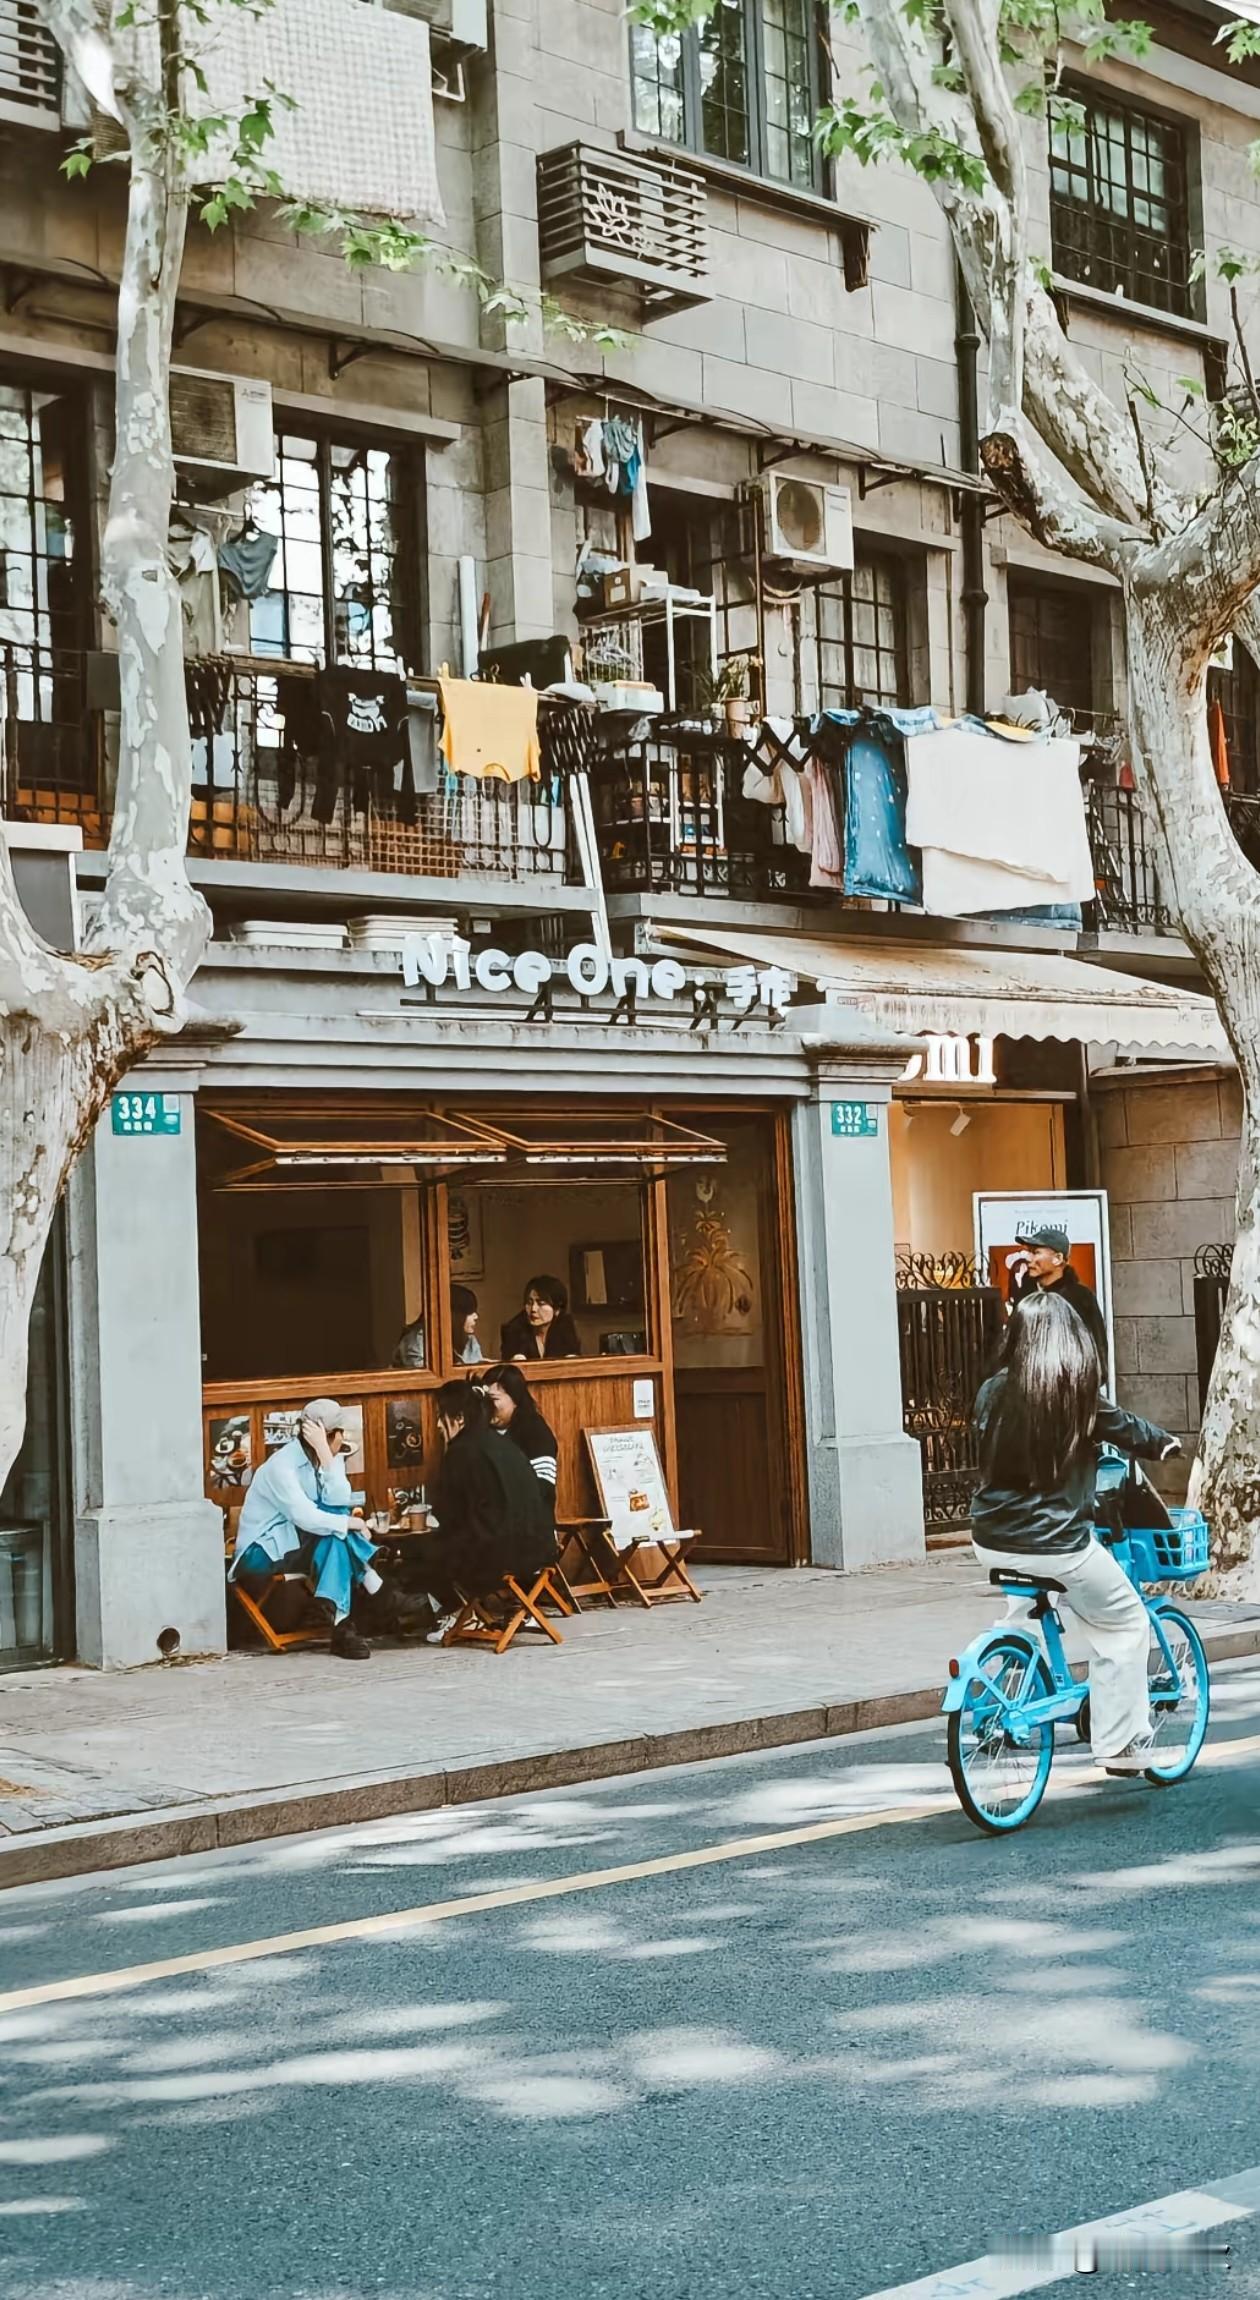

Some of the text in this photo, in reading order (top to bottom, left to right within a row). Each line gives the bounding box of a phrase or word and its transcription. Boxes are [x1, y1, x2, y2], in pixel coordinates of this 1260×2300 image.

[402, 931, 552, 994] Nice
[898, 1035, 998, 1083] mi
[118, 1096, 157, 1120] 334
[836, 1105, 862, 1124] 332
